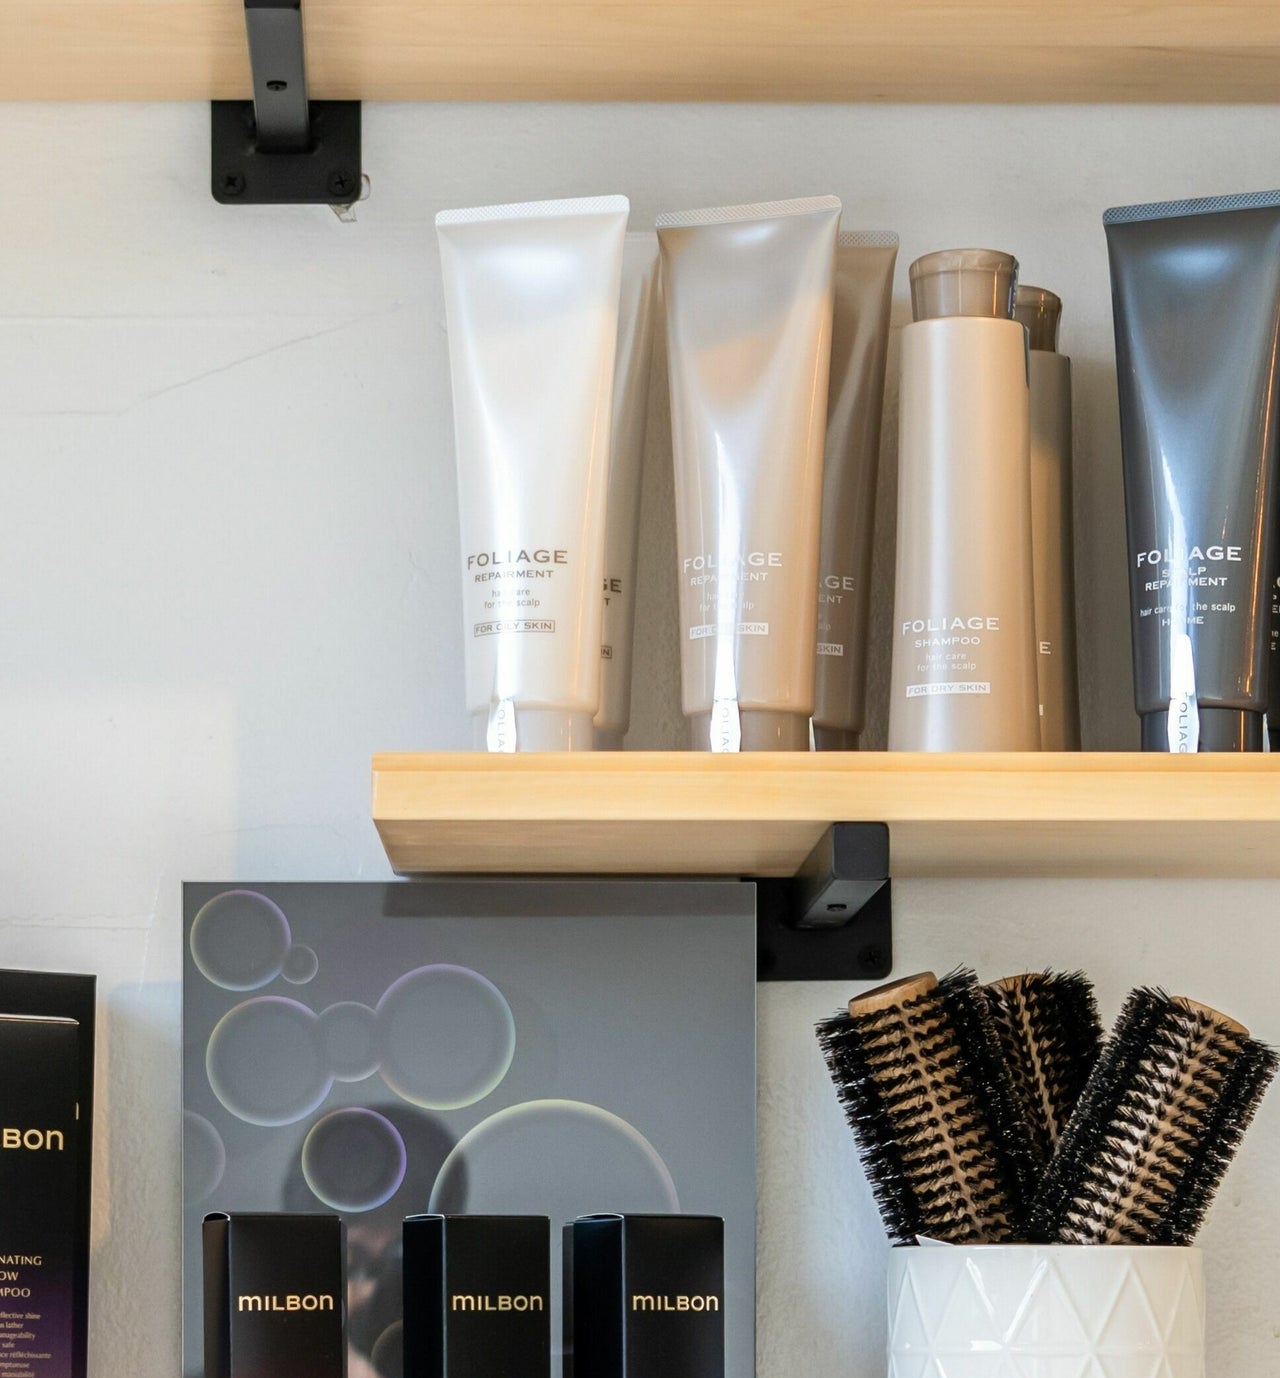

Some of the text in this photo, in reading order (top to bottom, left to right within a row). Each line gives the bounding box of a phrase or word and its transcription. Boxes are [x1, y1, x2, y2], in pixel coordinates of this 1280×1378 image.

[467, 550, 568, 570] FOLIAGE
[684, 552, 783, 574] FOLGE
[517, 599, 540, 607] scalp
[1211, 602, 1236, 613] scalp
[475, 621, 553, 634] FOR SKIN
[902, 617, 1000, 636] FOLIAGE
[914, 637, 981, 648] SHAMPOO
[945, 652, 966, 661] care
[917, 661, 977, 672] for scalp
[908, 683, 987, 695] FOR SKIN
